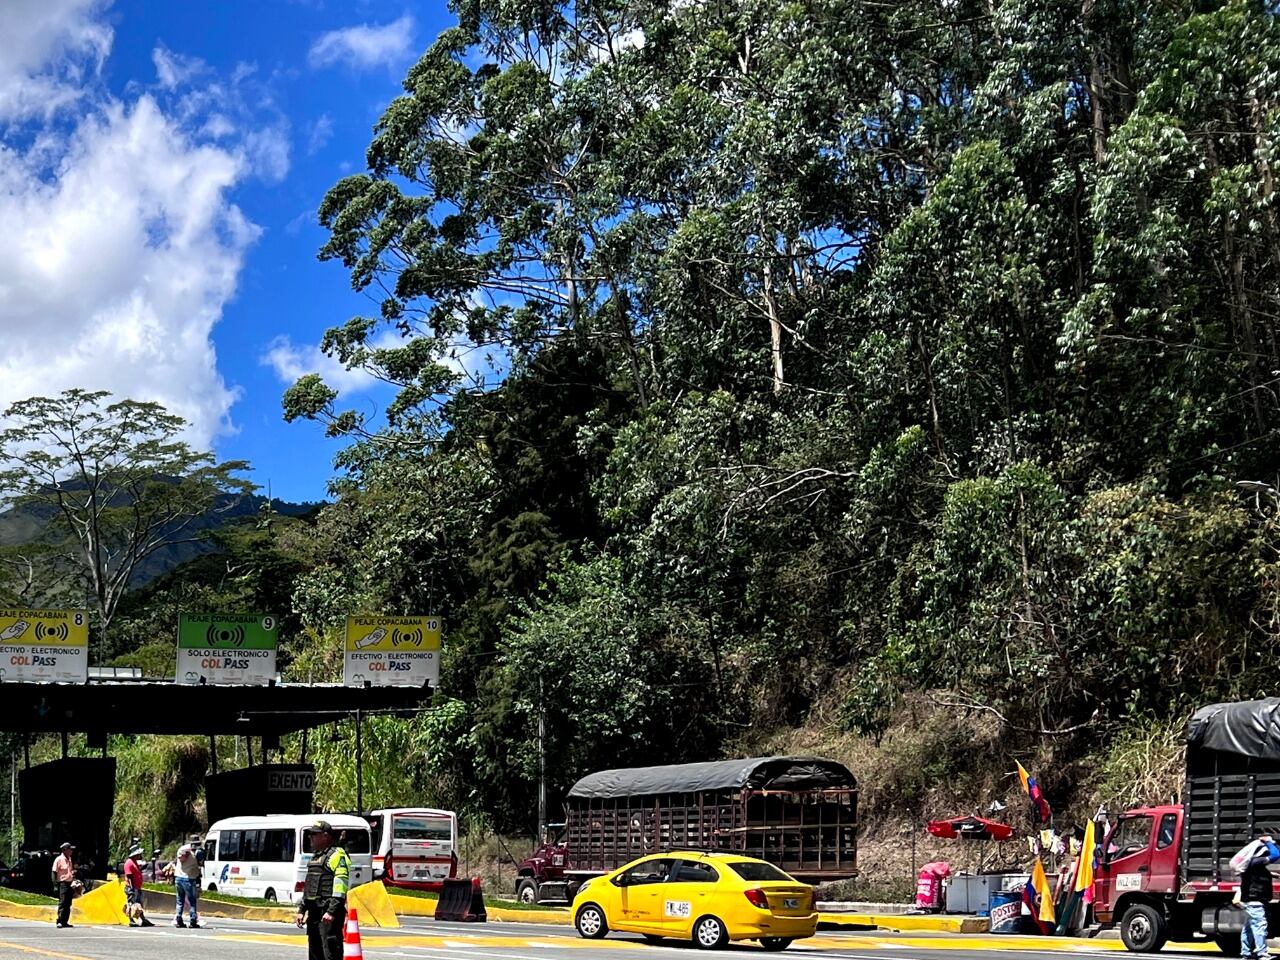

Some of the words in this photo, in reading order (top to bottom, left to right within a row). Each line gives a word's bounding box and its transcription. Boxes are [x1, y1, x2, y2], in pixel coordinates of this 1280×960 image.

[19, 611, 68, 619] COPACABANA
[75, 614, 82, 625] 8
[265, 618, 272, 629] 9
[427, 621, 437, 629] 10
[10, 656, 30, 665] COL
[201, 659, 221, 668] COL
[369, 662, 386, 671] COL
[270, 773, 312, 789] EXENTO
